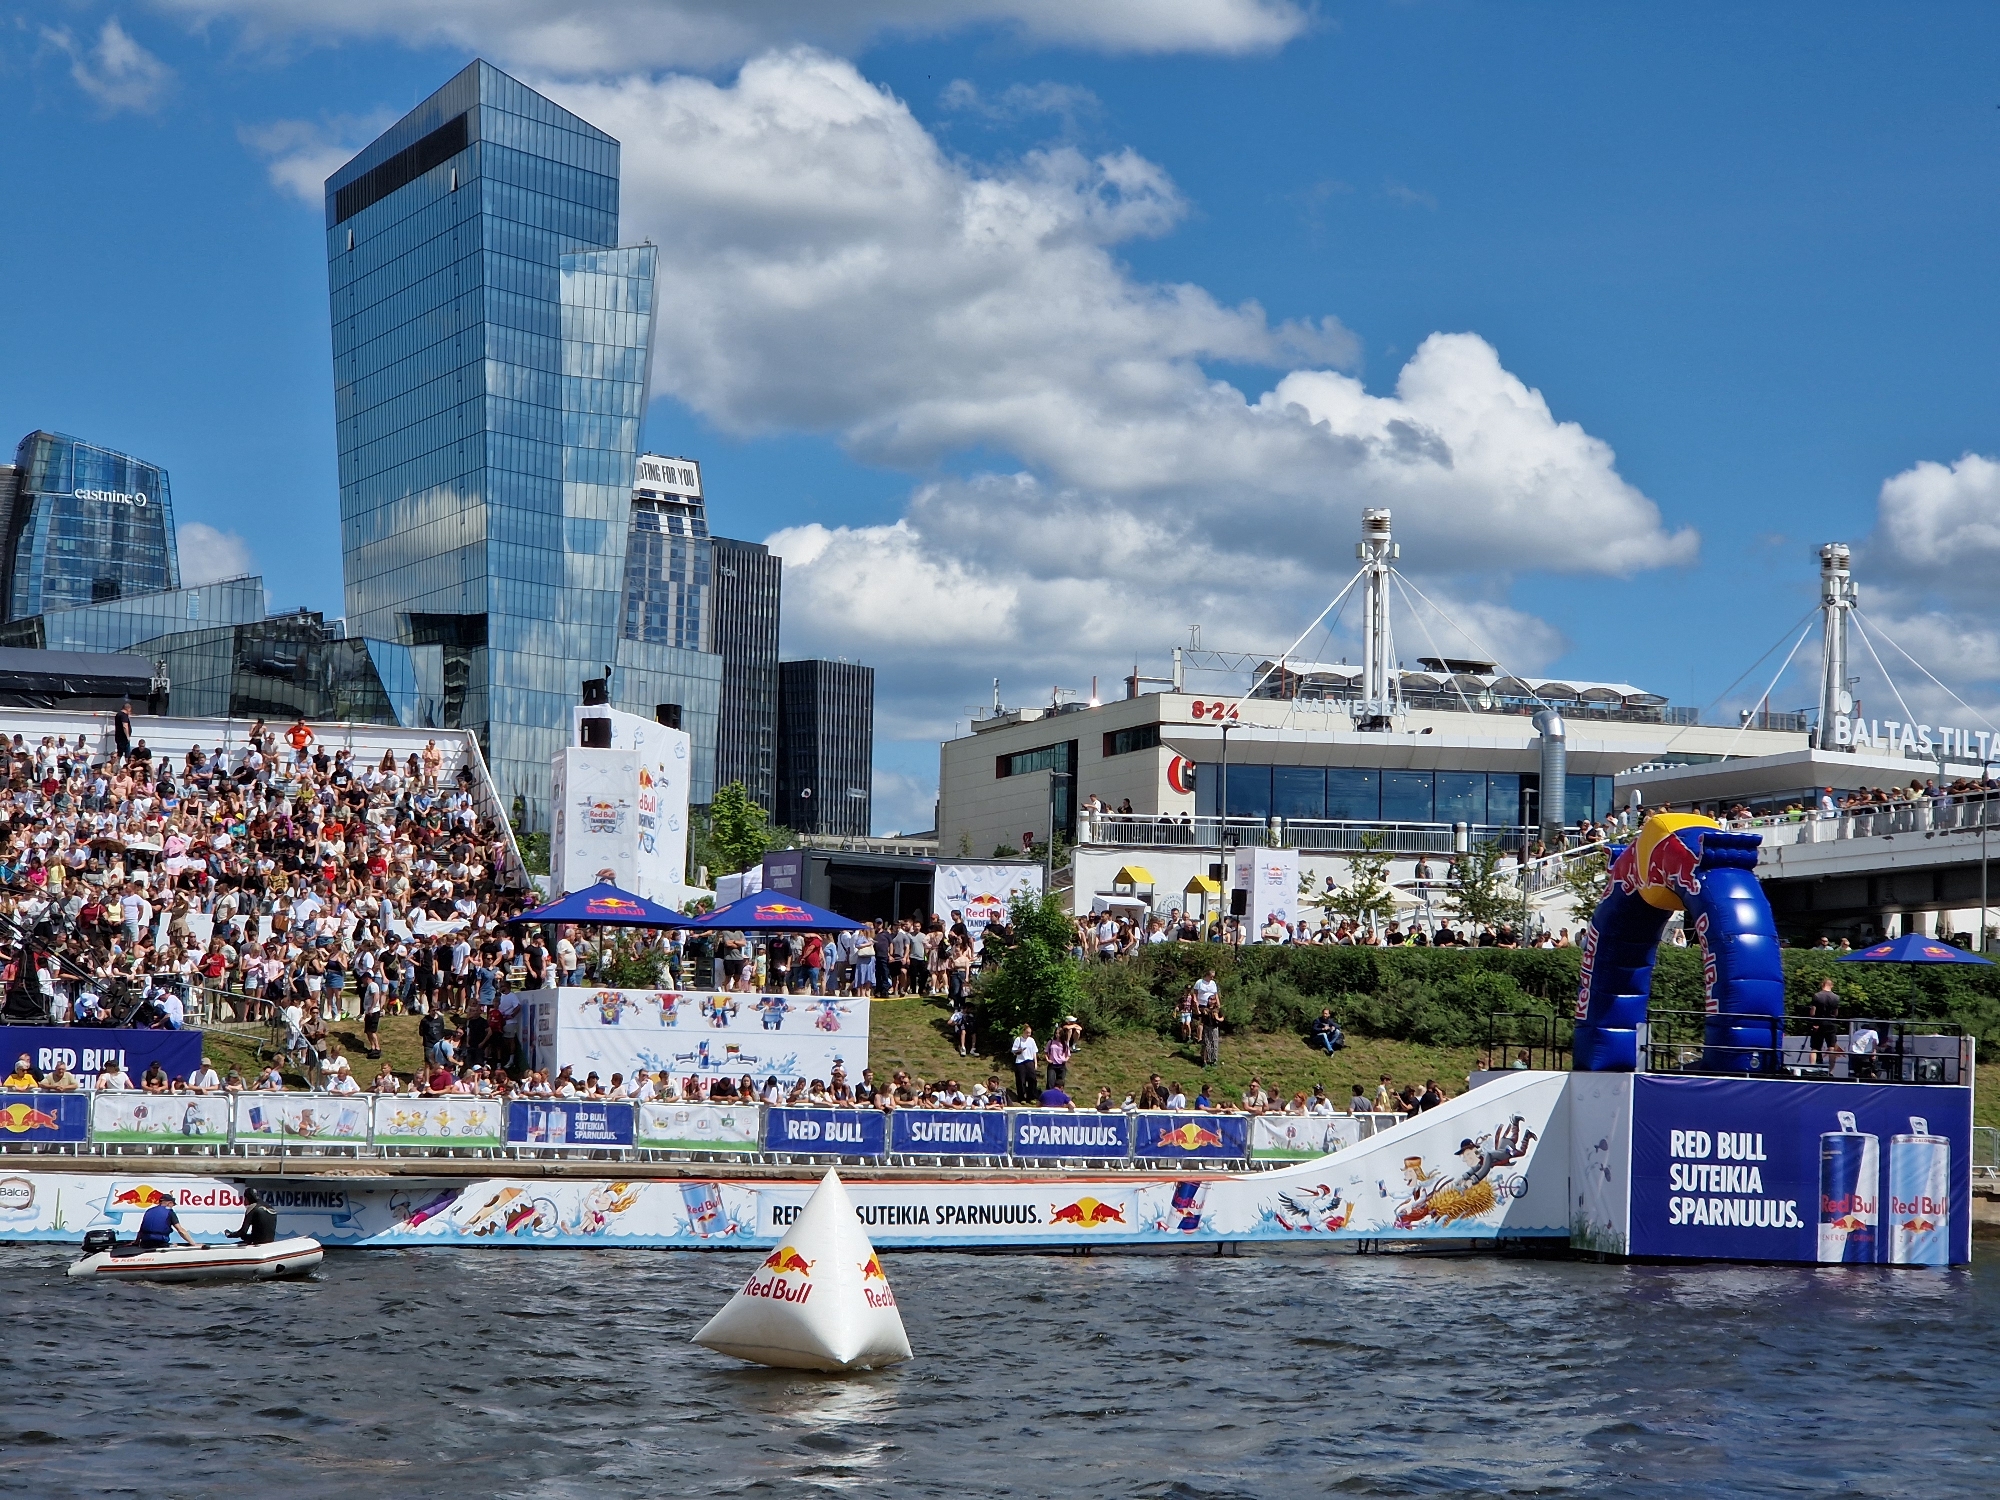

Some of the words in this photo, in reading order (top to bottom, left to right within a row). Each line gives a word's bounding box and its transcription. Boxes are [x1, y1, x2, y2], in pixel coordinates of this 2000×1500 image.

[661, 465, 677, 484] FOR
[677, 467, 695, 487] YOU
[74, 488, 134, 504] eastnine
[1292, 697, 1410, 717] NARVESEN
[1834, 715, 1933, 754] BALTAS
[603, 811, 616, 819] Bull
[966, 908, 985, 918] Red
[1582, 921, 1600, 972] Bull
[1695, 912, 1717, 967] Red
[1575, 971, 1593, 1020] Red
[682, 1078, 708, 1090] Rd
[574, 1121, 605, 1130] SUTEIKIA
[575, 1112, 589, 1121] RED
[590, 1113, 607, 1122] BULL
[788, 1120, 821, 1140] RED
[824, 1122, 864, 1143] BULL
[911, 1122, 983, 1143] SUTEIKIA
[1020, 1125, 1123, 1146] SPARNUUUS.
[1670, 1129, 1712, 1158] RED
[1717, 1131, 1767, 1161] BULL
[1669, 1163, 1764, 1193] SUTEIKIA
[0, 1187, 30, 1197] Balcia
[180, 1189, 216, 1206] Red
[686, 1203, 705, 1214] Red
[1669, 1196, 1804, 1228] SPARNUUUS.
[1821, 1193, 1850, 1214] Red
[1852, 1194, 1877, 1214] Bull
[1891, 1196, 1919, 1214] Red
[1921, 1196, 1948, 1215] Bull
[856, 1205, 930, 1225] SUTEIKIA
[935, 1204, 1043, 1225] SPARNUUUS.
[1899, 1235, 1939, 1243] ZERO
[743, 1275, 775, 1298] Red
[773, 1278, 813, 1304] Bull
[863, 1284, 888, 1309] Red
